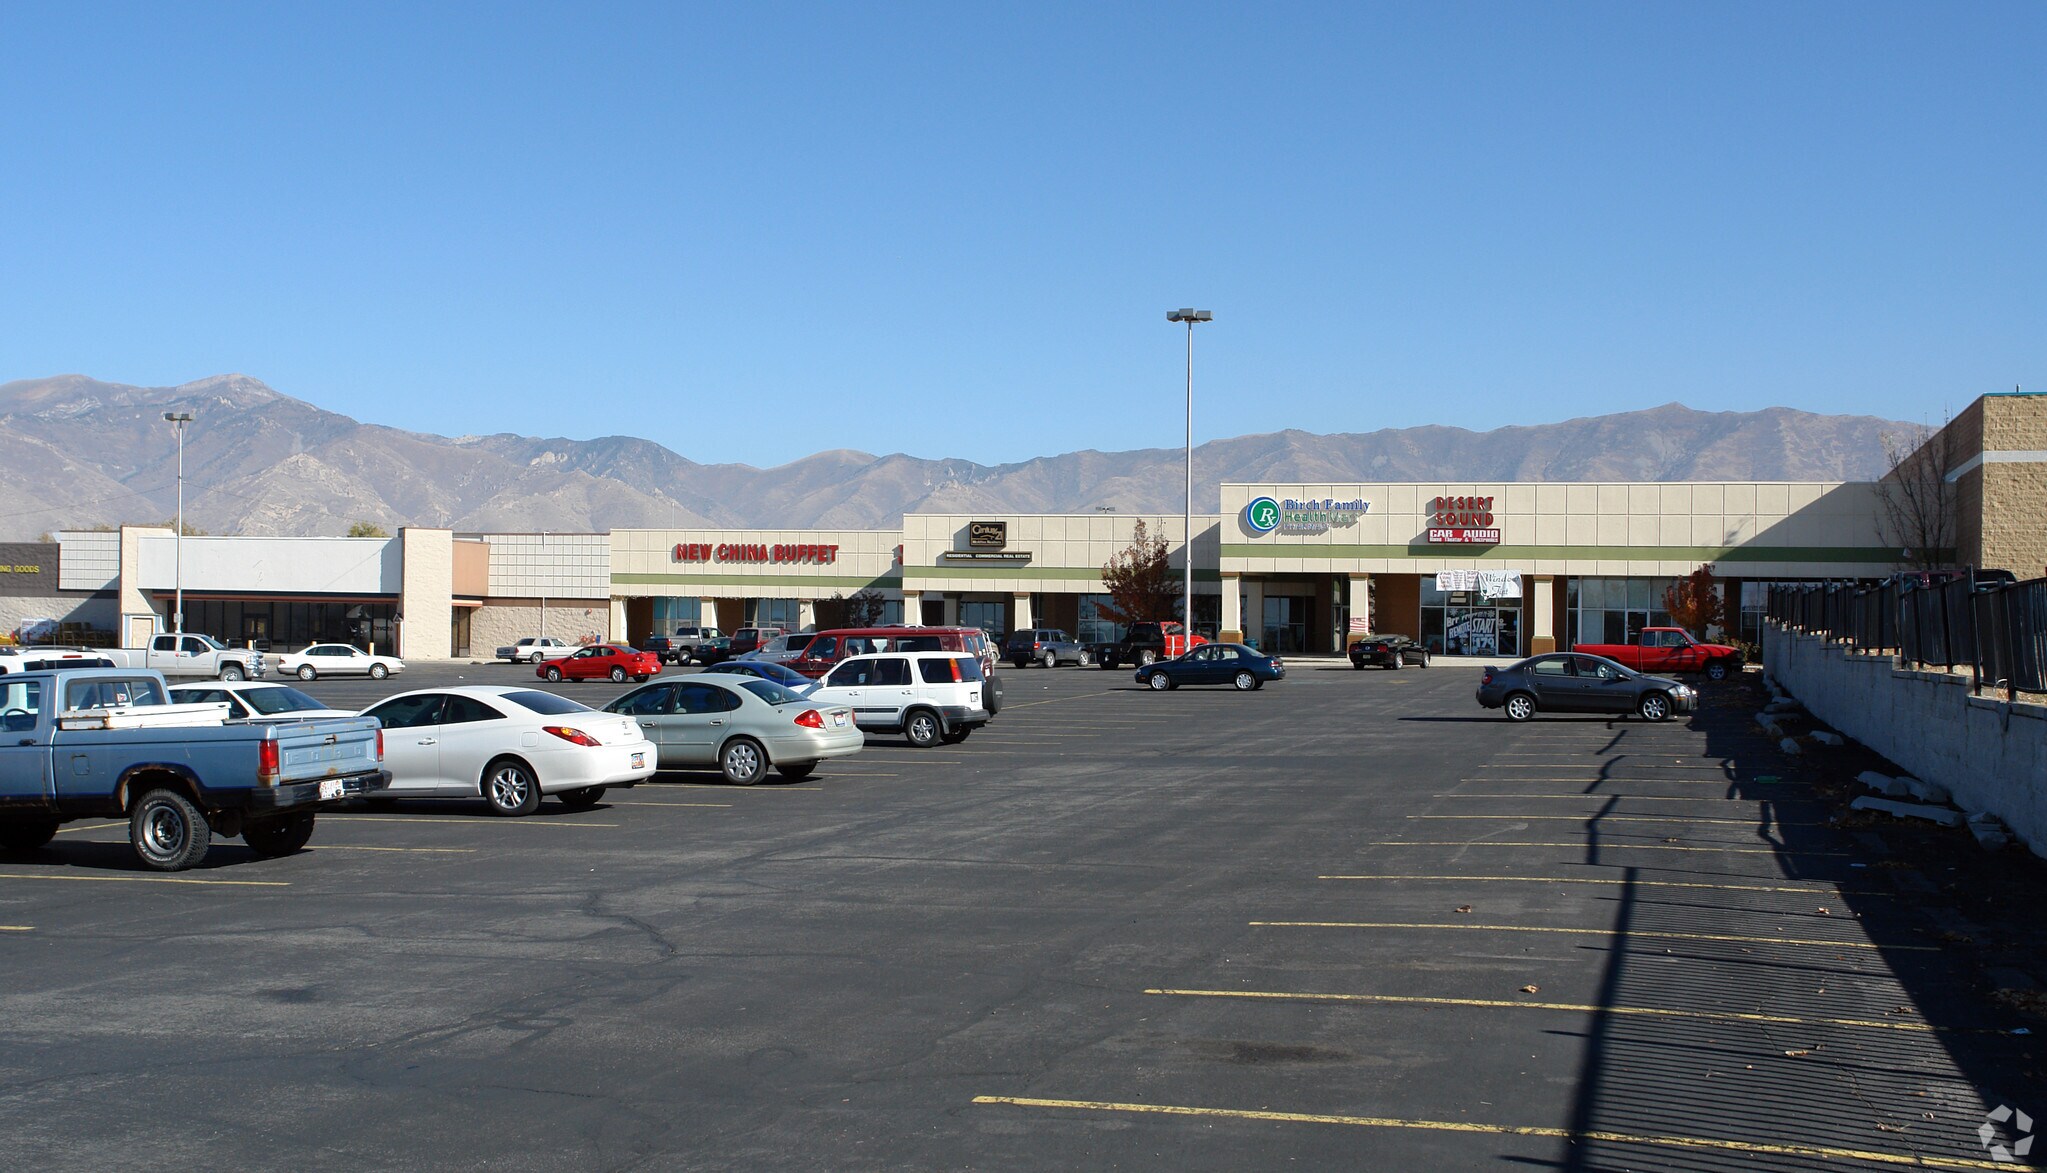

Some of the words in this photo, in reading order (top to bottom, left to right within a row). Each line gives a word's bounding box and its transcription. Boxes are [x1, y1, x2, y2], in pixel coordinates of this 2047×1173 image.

[1284, 498, 1320, 510] Birch
[1325, 498, 1371, 514] Family
[1435, 496, 1494, 511] DESERT
[1284, 511, 1327, 523] Health
[1435, 512, 1494, 527] SOUND
[1429, 529, 1453, 538] CAR
[1463, 529, 1499, 538] AUDIO
[676, 543, 713, 561] NEW
[717, 543, 769, 561] CHINA
[774, 544, 839, 562] BUFFET
[14, 565, 40, 573] GOODS
[1472, 618, 1496, 634] START
